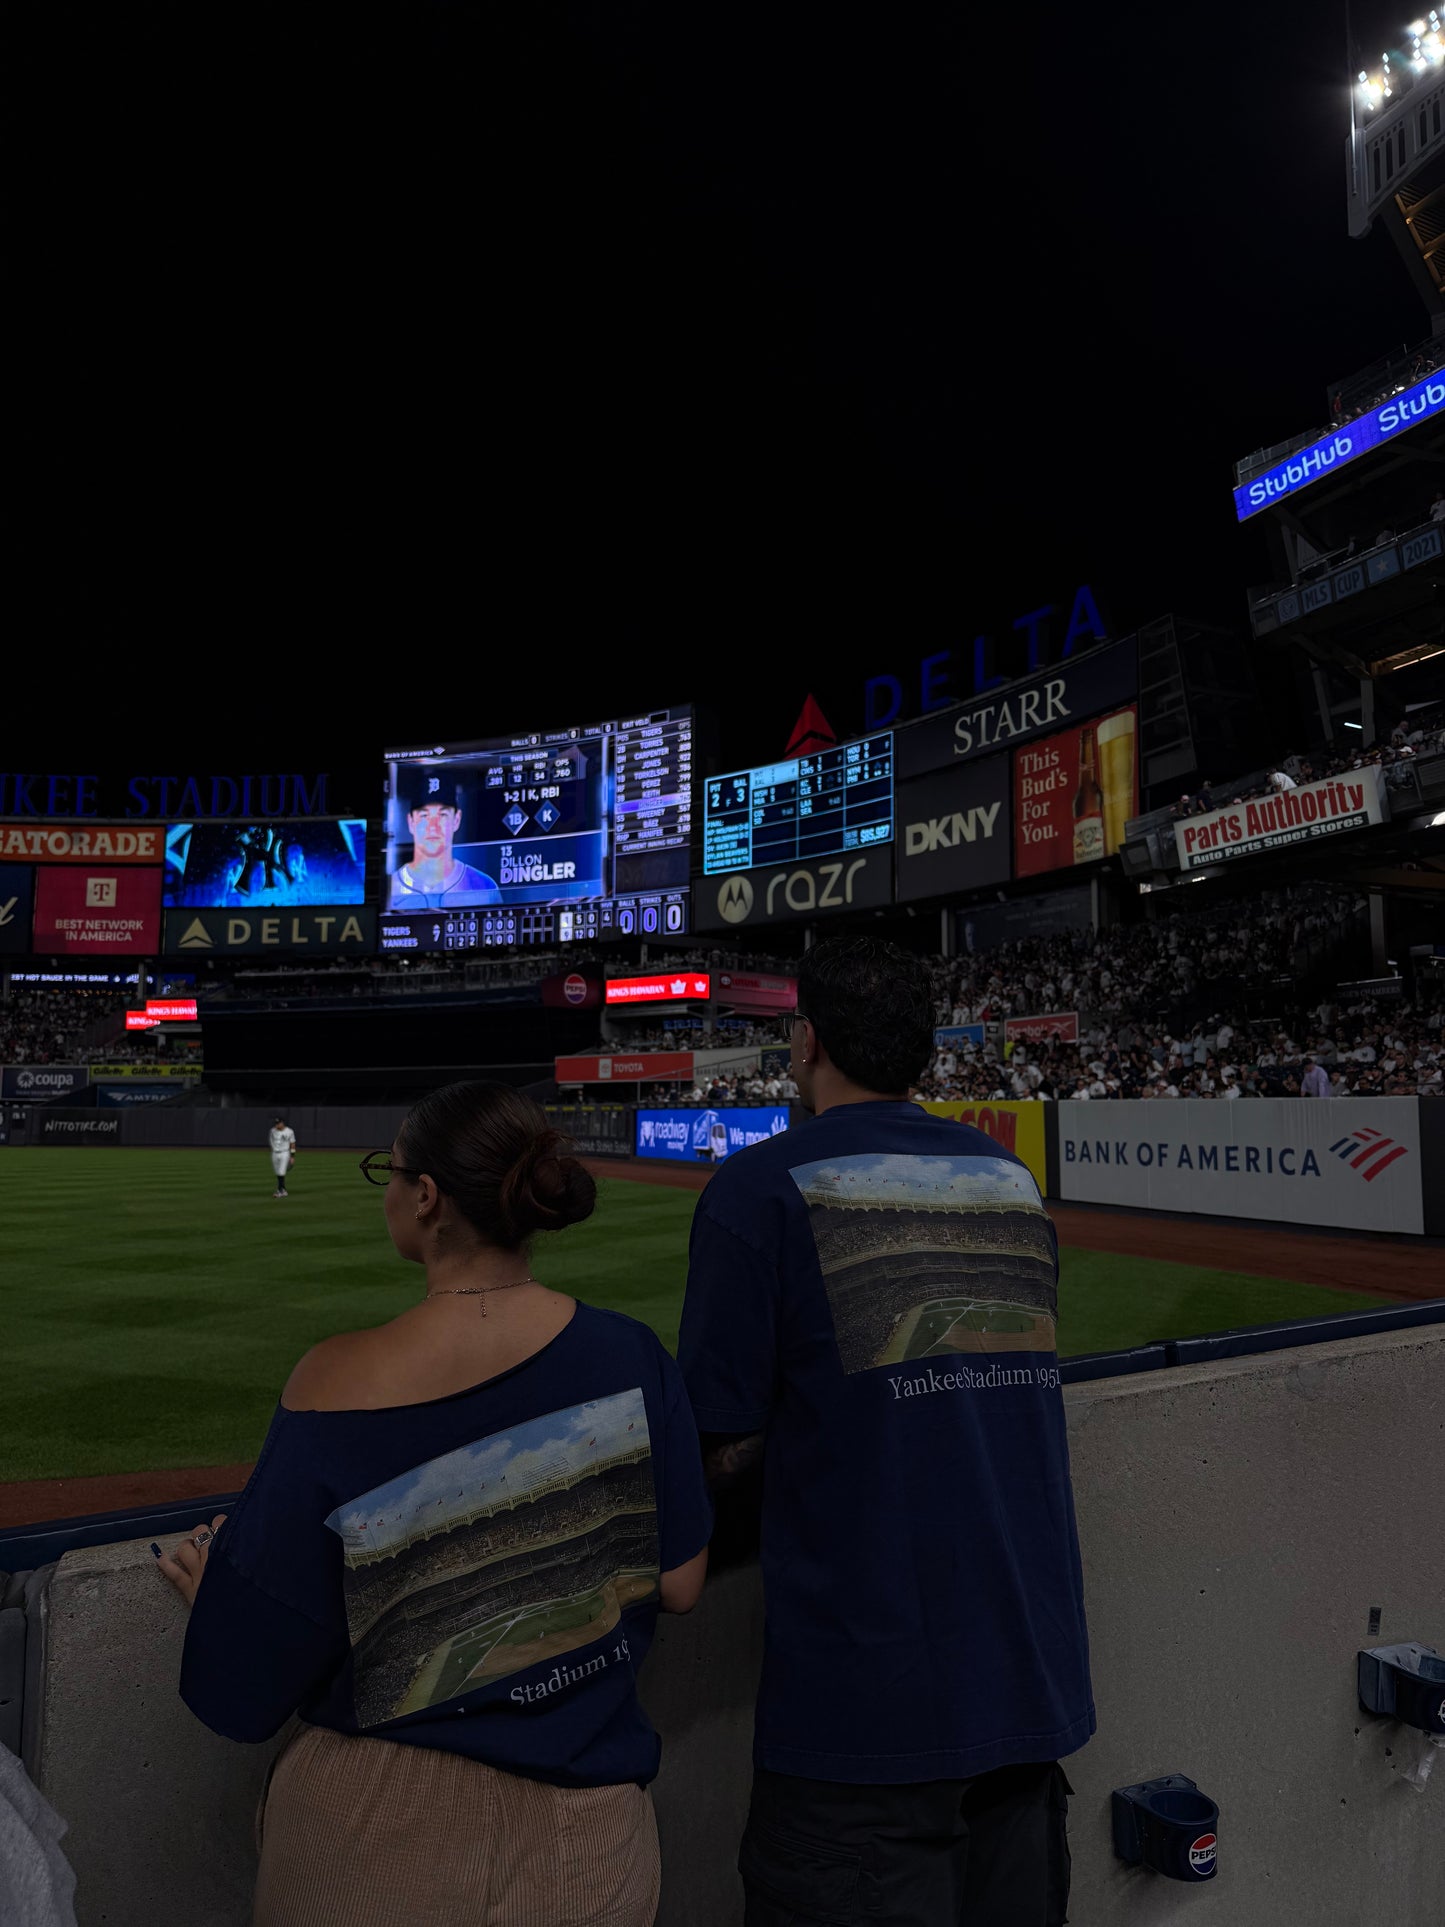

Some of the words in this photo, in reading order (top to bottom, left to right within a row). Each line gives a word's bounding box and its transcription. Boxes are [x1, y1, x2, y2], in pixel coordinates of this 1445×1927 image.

[1378, 384, 1445, 432] Stub
[1249, 437, 1352, 506] StubHub
[1304, 585, 1327, 609] MLS
[1337, 571, 1360, 595] CUP
[1406, 535, 1437, 564] 2021
[864, 584, 1107, 731] DELTA
[954, 679, 1071, 755] STARR
[1020, 747, 1059, 776] This
[125, 773, 330, 818] STADIUM
[541, 786, 559, 798] RBI
[1021, 767, 1068, 799] Bud's
[711, 793, 720, 807] 2
[736, 788, 745, 802] 3
[1022, 800, 1050, 822] For
[509, 813, 522, 825] 1B
[542, 810, 552, 822] K
[905, 802, 1001, 856] DKNY
[1184, 815, 1242, 853] Parts
[1246, 782, 1364, 837] Authority
[1021, 822, 1058, 845] You.
[1193, 850, 1221, 865] Auto
[1225, 841, 1261, 857] Parts
[1264, 831, 1307, 847] Super
[1311, 815, 1364, 836] Stores
[501, 845, 513, 857] 13
[501, 854, 542, 868] DILLON
[500, 861, 576, 884] DINGLER
[767, 858, 867, 916] razr
[55, 919, 84, 930] BEST
[85, 919, 144, 931] NETWORK
[227, 916, 364, 945] DELTA
[382, 926, 411, 936] TIGERS
[448, 922, 454, 932] 0
[460, 922, 464, 932] 1
[469, 921, 476, 931] 0
[486, 921, 493, 930] 0
[497, 920, 503, 930] 0
[508, 919, 514, 929] 0
[588, 913, 594, 923] 0
[620, 910, 633, 934] 0
[643, 907, 657, 932] 0
[667, 905, 681, 930] 0
[65, 932, 79, 941] IN
[79, 931, 132, 942] AMERICA
[382, 938, 418, 948] YANKEES
[448, 937, 452, 947] 1
[458, 936, 464, 946] 2
[469, 936, 476, 946] 2
[497, 935, 503, 944] 0
[508, 934, 514, 944] 0
[588, 928, 594, 938] 0
[566, 985, 585, 993] PEPSI
[35, 1073, 74, 1088] coupa
[614, 1063, 643, 1072] TOYOTA
[654, 1118, 689, 1145] roadway
[729, 1128, 744, 1145] We
[1065, 1140, 1128, 1165] BANK
[1136, 1142, 1168, 1167] OF
[1177, 1144, 1321, 1177] AMERICA
[510, 1653, 608, 1706] Stadium
